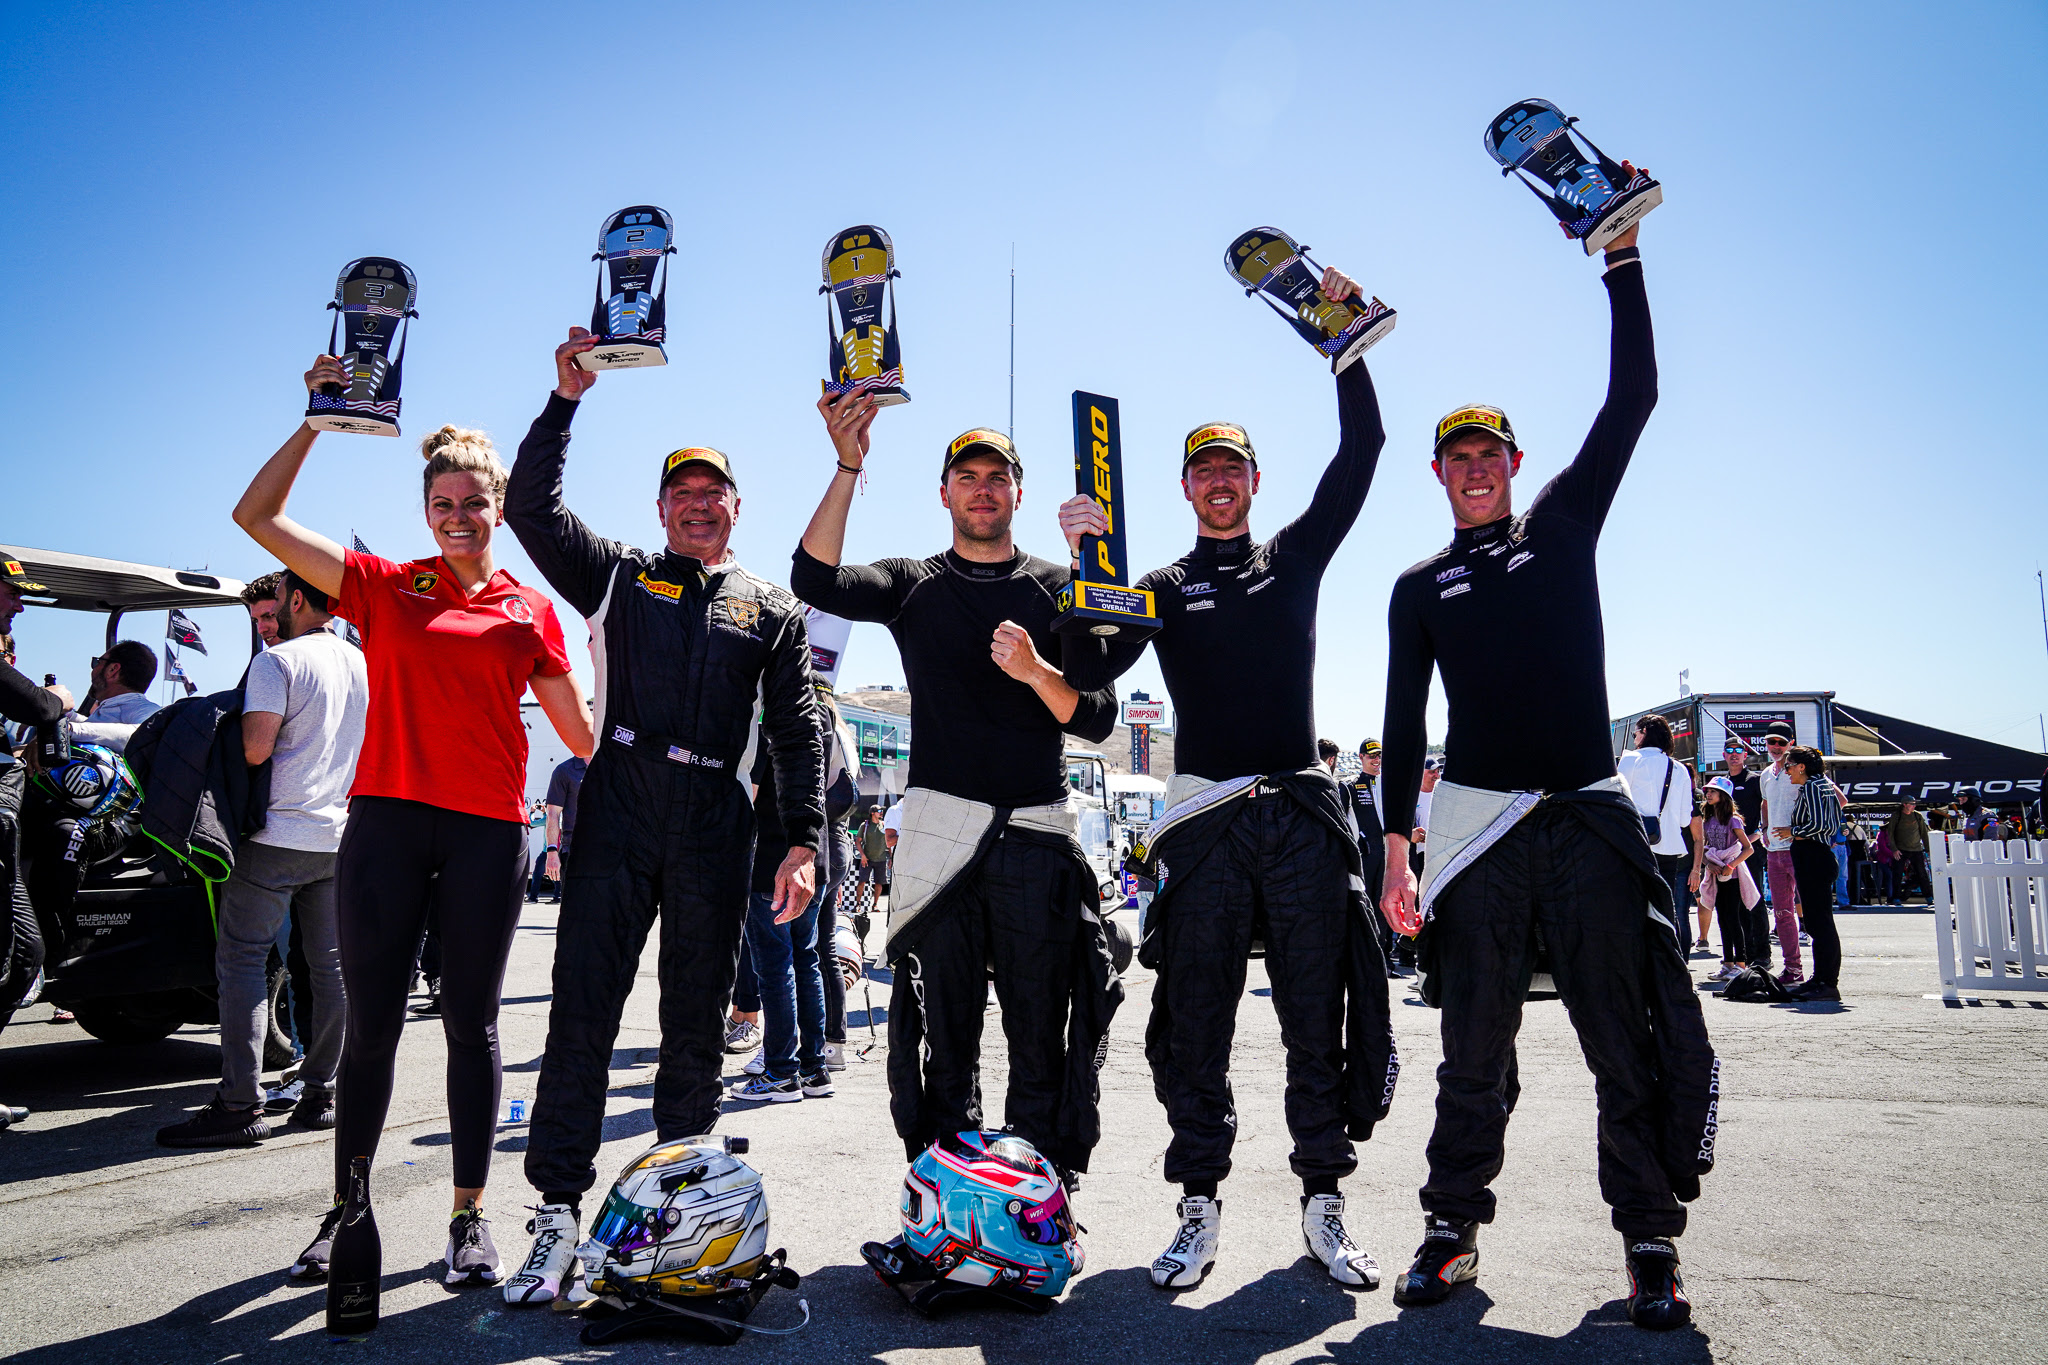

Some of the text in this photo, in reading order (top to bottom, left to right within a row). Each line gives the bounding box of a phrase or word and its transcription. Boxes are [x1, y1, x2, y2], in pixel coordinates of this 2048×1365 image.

[1442, 410, 1497, 432] PIRELLI
[1090, 405, 1116, 577] P ZERO
[1436, 566, 1466, 582] WTR
[643, 576, 679, 596] PIRELLI
[1181, 582, 1211, 594] WTR
[1101, 603, 1132, 613] OVERALL
[1186, 599, 1215, 611] prestige
[1128, 709, 1160, 719] SIMPSON
[613, 728, 636, 743] OMP
[690, 754, 725, 769] R. Sellari
[1919, 779, 2043, 799] PHOR
[76, 912, 131, 922] CUSHMAN
[95, 928, 112, 936] EFI
[1381, 1053, 1400, 1106] ROGER
[1324, 1203, 1341, 1211] OMP
[1029, 1208, 1044, 1219] WTR
[537, 1217, 554, 1227] OMP
